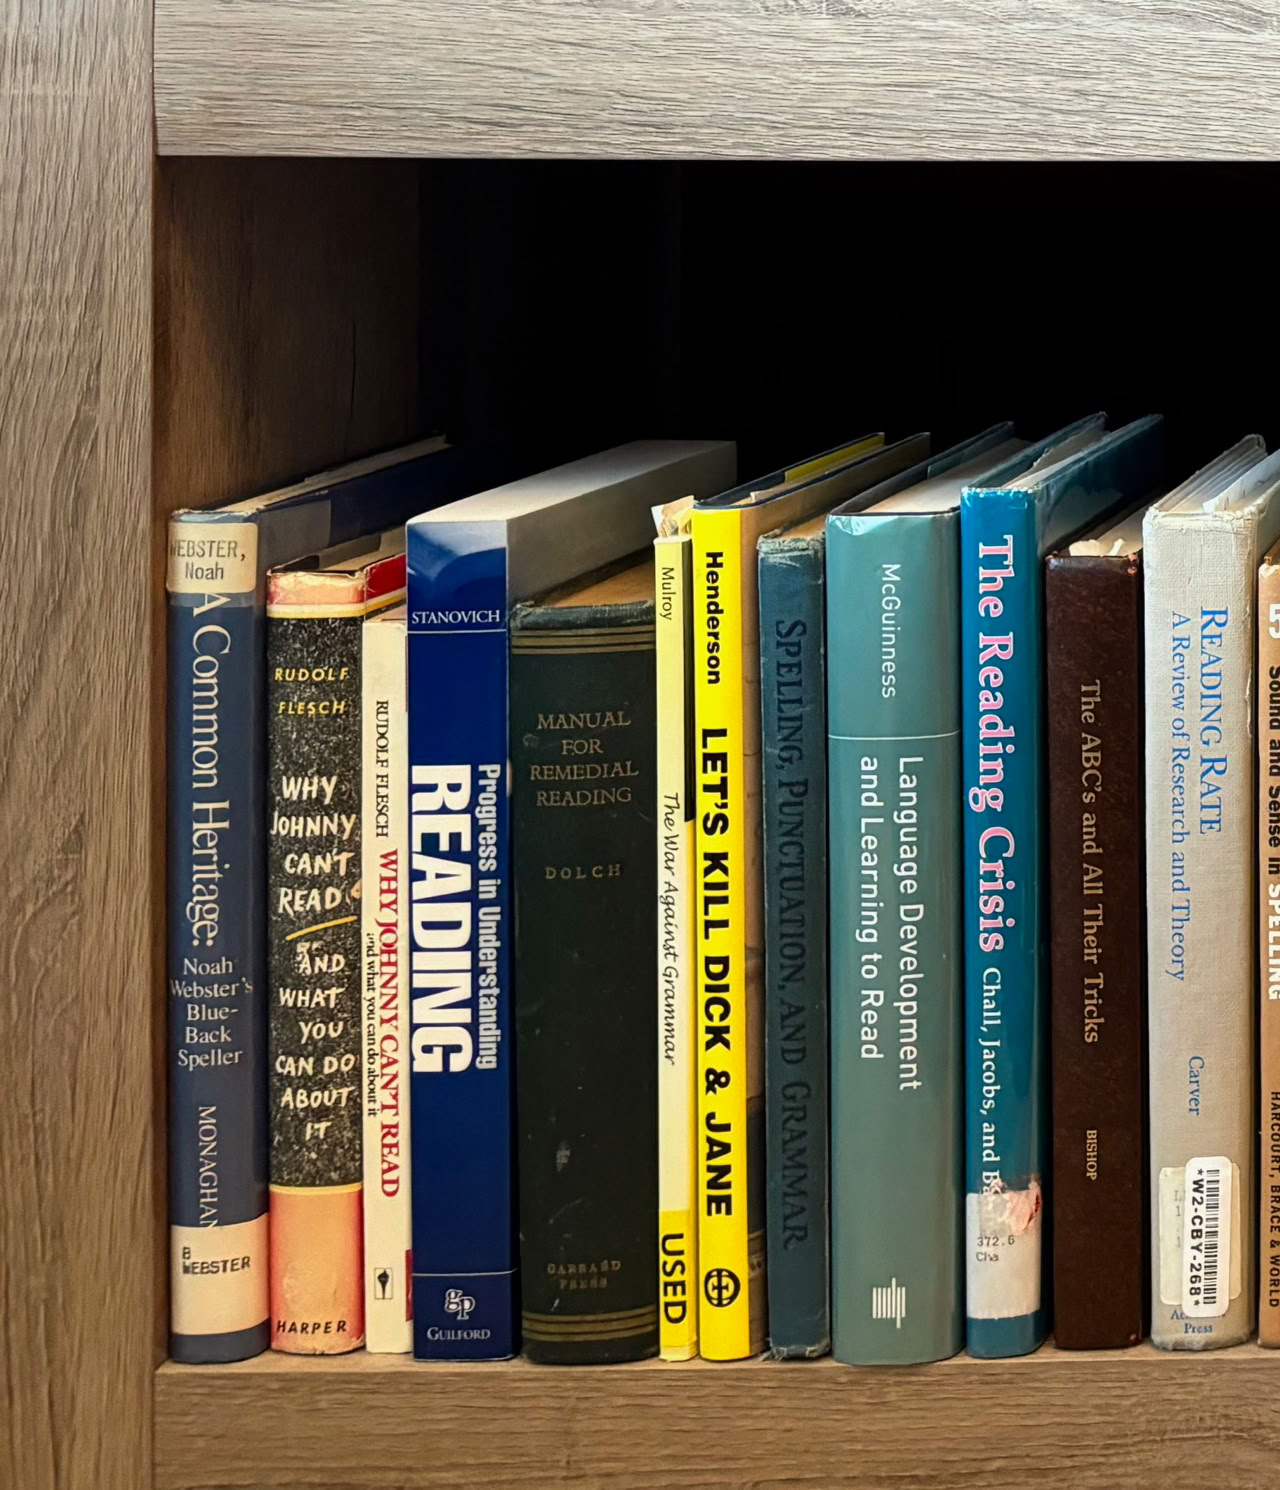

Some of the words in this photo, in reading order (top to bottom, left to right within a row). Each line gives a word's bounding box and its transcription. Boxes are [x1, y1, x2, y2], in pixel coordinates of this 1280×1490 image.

[184, 563, 225, 581] Noah
[660, 566, 674, 621] Mulroy
[977, 534, 1015, 617] The
[412, 610, 500, 625] STANOVICH
[705, 551, 724, 685] Henderson
[881, 563, 902, 699] McGuinness
[274, 668, 350, 683] RUDOLF
[1080, 680, 1102, 723] The
[1172, 632, 1191, 711] Review
[191, 625, 231, 789] Common
[277, 702, 345, 715] FLESCH
[376, 700, 389, 768] RUDOLF
[537, 711, 631, 730] MANUAL
[968, 632, 1015, 812] Reading
[529, 761, 639, 781] REMEDIAL
[562, 739, 604, 755] FOR
[1080, 733, 1103, 805] ABC's
[282, 776, 337, 804] WHY
[376, 774, 389, 839] FLESCH
[536, 788, 632, 807] READING
[702, 728, 730, 837] LET'S
[1172, 747, 1191, 844] Research
[270, 813, 357, 837] JOHNNY
[477, 764, 501, 872] Progress
[893, 756, 924, 894] Language
[185, 800, 230, 946] Heritage:
[284, 852, 355, 875] CAN'T
[379, 847, 399, 913] WHY
[545, 864, 622, 879] DOLCH
[663, 835, 678, 877] War
[856, 818, 884, 943] Learning
[978, 826, 1015, 952] Crisis
[278, 888, 342, 914] READ
[412, 766, 473, 1073] READING
[658, 880, 680, 960] Against
[702, 852, 730, 940] KILL
[182, 958, 234, 975] Noah
[1082, 904, 1104, 965] Their
[1166, 899, 1190, 982] Theory
[169, 978, 254, 997] Webster's
[278, 988, 344, 1008] WHAT
[378, 919, 399, 1029] JOHNNY
[476, 902, 501, 1070] Understanding
[704, 954, 731, 1052] DICK
[894, 904, 924, 1090] Development
[982, 967, 1002, 1031] Chall,
[185, 1027, 232, 1043] Back
[187, 1006, 239, 1022] Blue-
[299, 1021, 343, 1043] YOU
[662, 965, 680, 1065] Grammar
[860, 990, 885, 1059] Read
[1084, 972, 1105, 1043] Tricks
[177, 1048, 243, 1071] Speller
[275, 1055, 315, 1075] CAN
[379, 1034, 400, 1117] CAN'T
[978, 1036, 1002, 1115] Jacobs,
[1188, 1055, 1205, 1116] Carver
[280, 1086, 355, 1108] ABOUT
[380, 1121, 400, 1198] READ
[705, 1112, 733, 1217] JANE
[781, 1081, 812, 1251] GRAMMAR
[1086, 1129, 1098, 1181] BISHOP
[660, 1233, 688, 1324] USED
[276, 1319, 347, 1334] HARPER
[427, 1326, 491, 1340] GUILFORD
